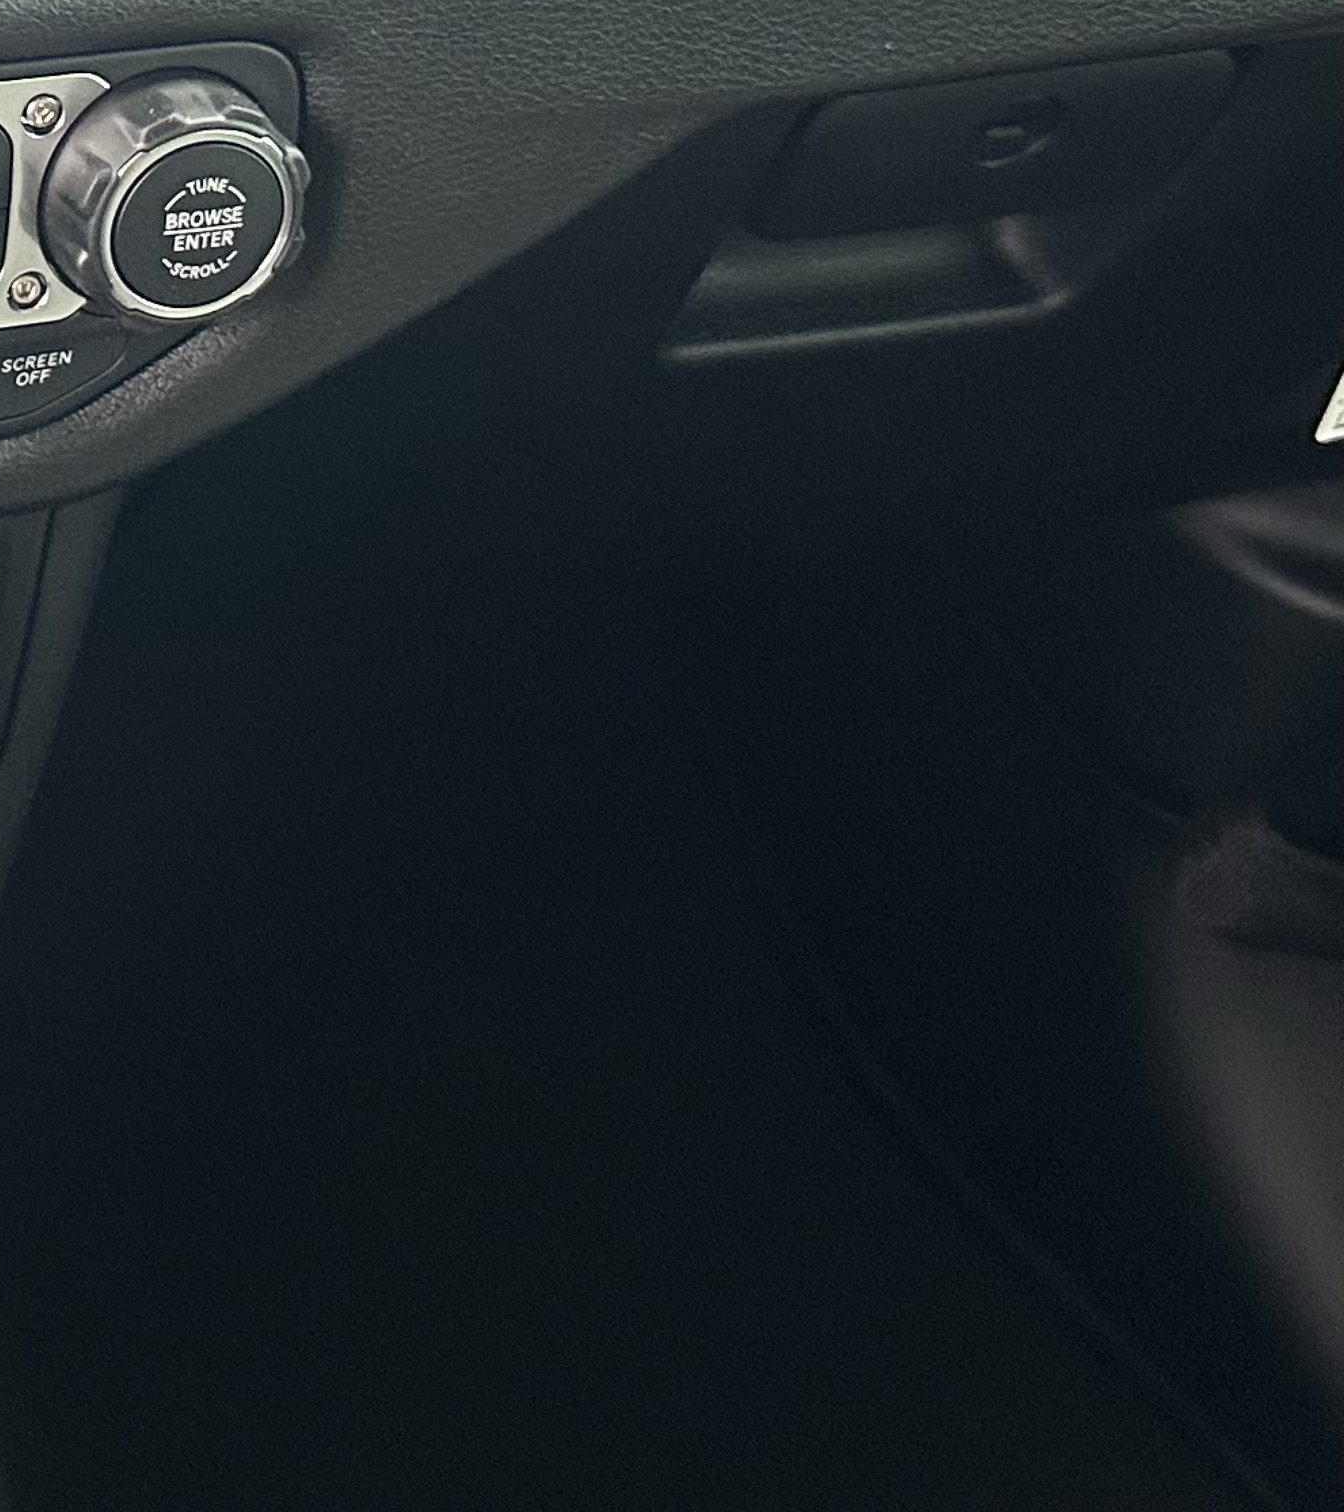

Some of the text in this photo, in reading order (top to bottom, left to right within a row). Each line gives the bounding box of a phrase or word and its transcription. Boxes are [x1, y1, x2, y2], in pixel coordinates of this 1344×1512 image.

[185, 177, 229, 196] TUNE
[164, 205, 244, 231] BROWSE
[173, 230, 235, 252] ENTER
[169, 258, 230, 280] SCROLL
[1, 349, 73, 375] SCREEN
[15, 367, 52, 387] OFF
